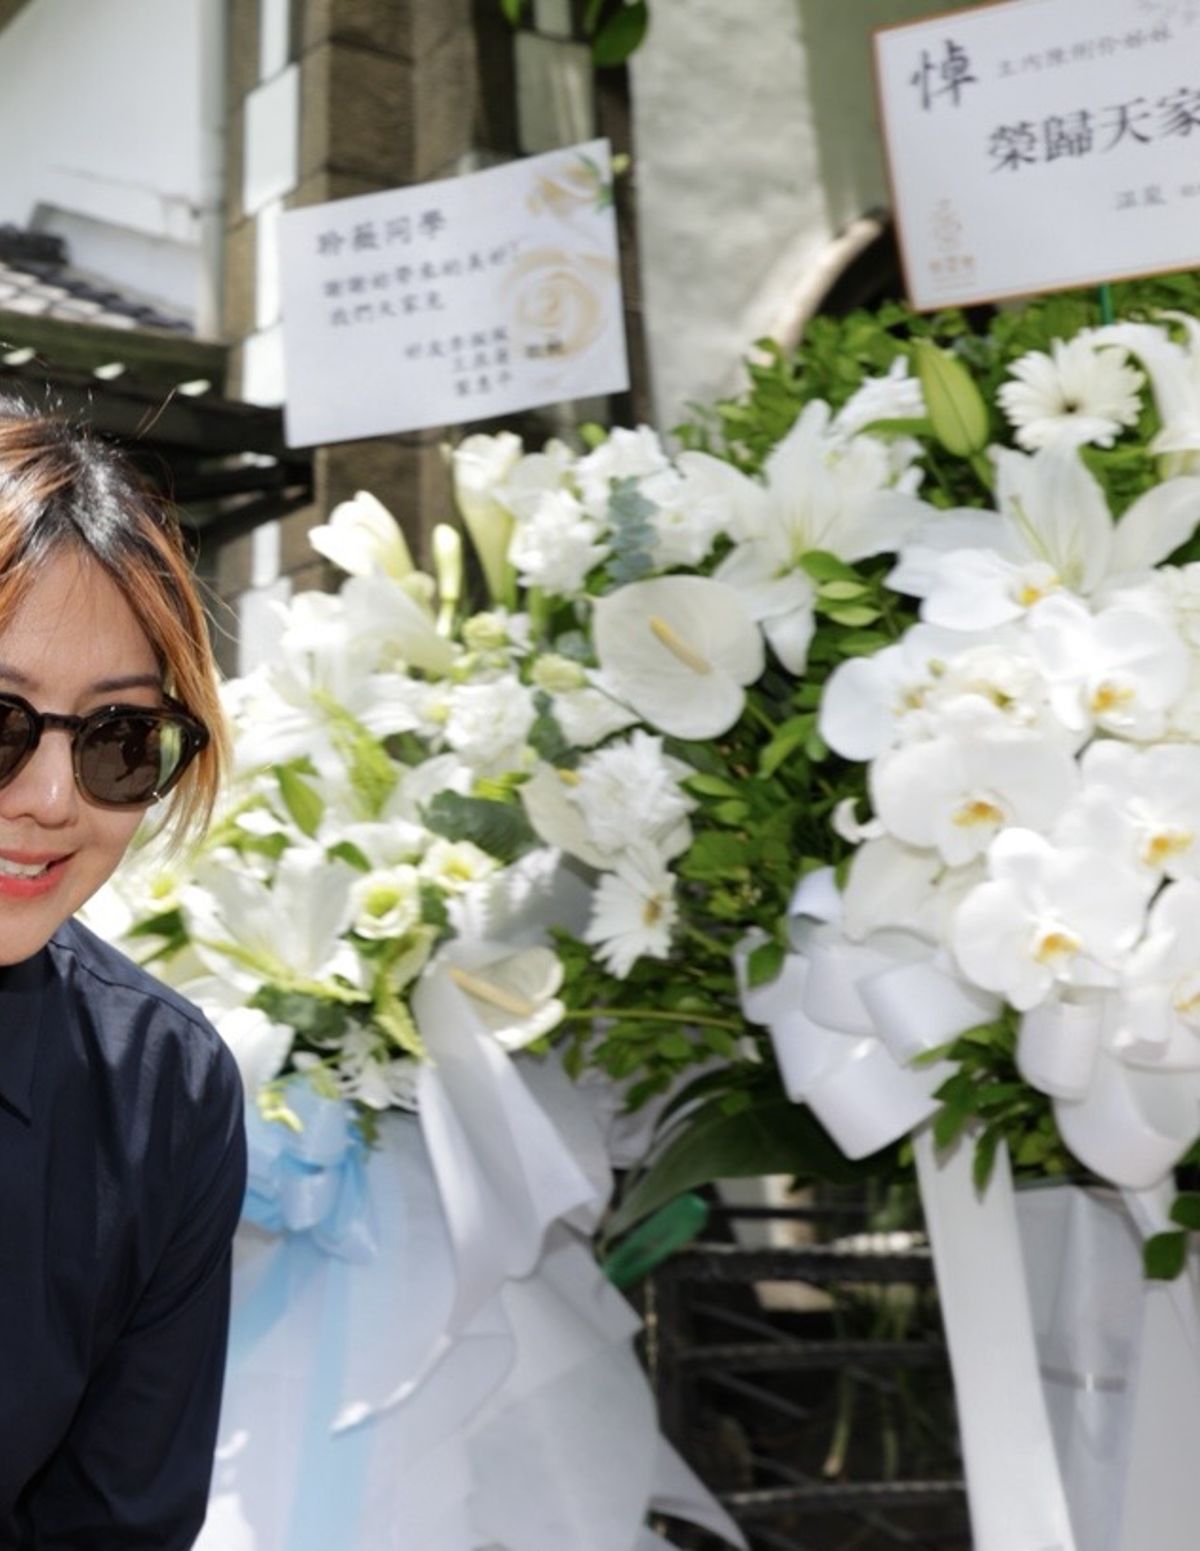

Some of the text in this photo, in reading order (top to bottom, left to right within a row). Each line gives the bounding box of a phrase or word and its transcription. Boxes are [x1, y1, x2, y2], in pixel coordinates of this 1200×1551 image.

[909, 38, 978, 111] 悼
[988, 86, 1200, 173] 榮歸天家
